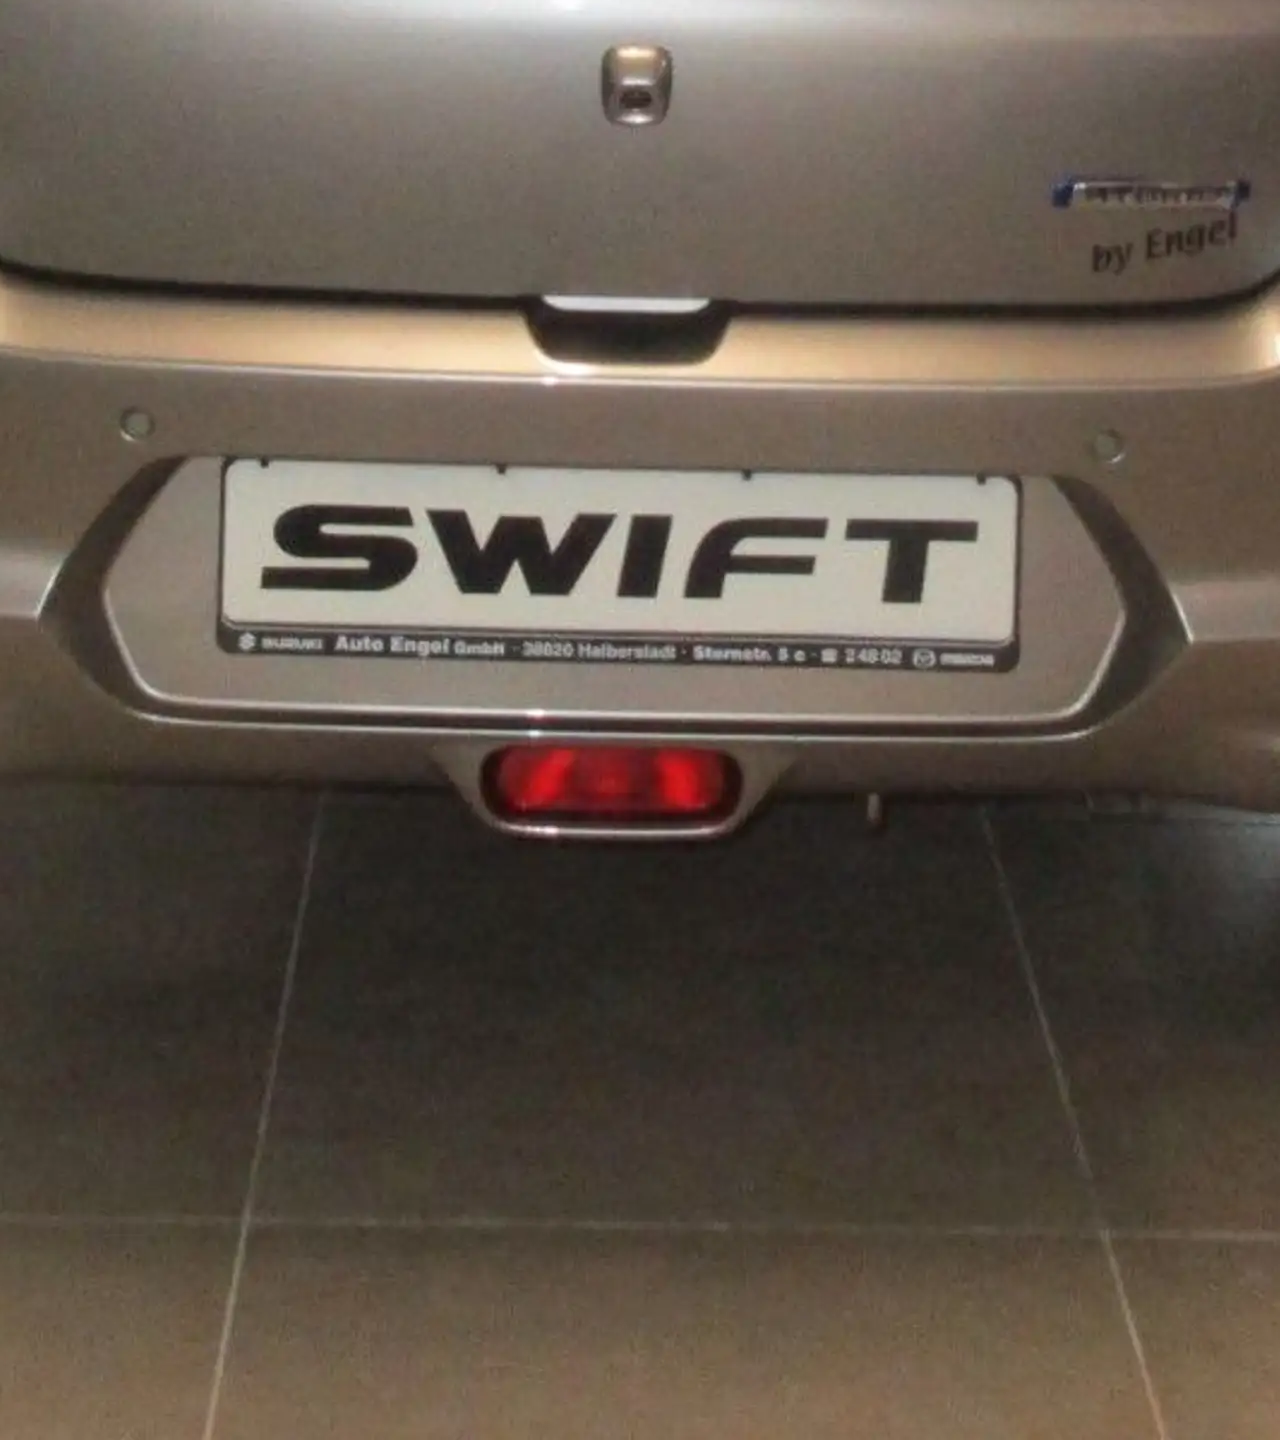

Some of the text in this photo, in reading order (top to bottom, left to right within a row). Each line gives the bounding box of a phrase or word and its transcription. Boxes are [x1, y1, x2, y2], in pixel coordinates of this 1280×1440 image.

[1091, 210, 1237, 276] by Engel
[259, 502, 979, 604] SWIFT
[334, 635, 384, 652] Auto
[389, 635, 451, 655] Engel
[454, 641, 505, 656] GmbH
